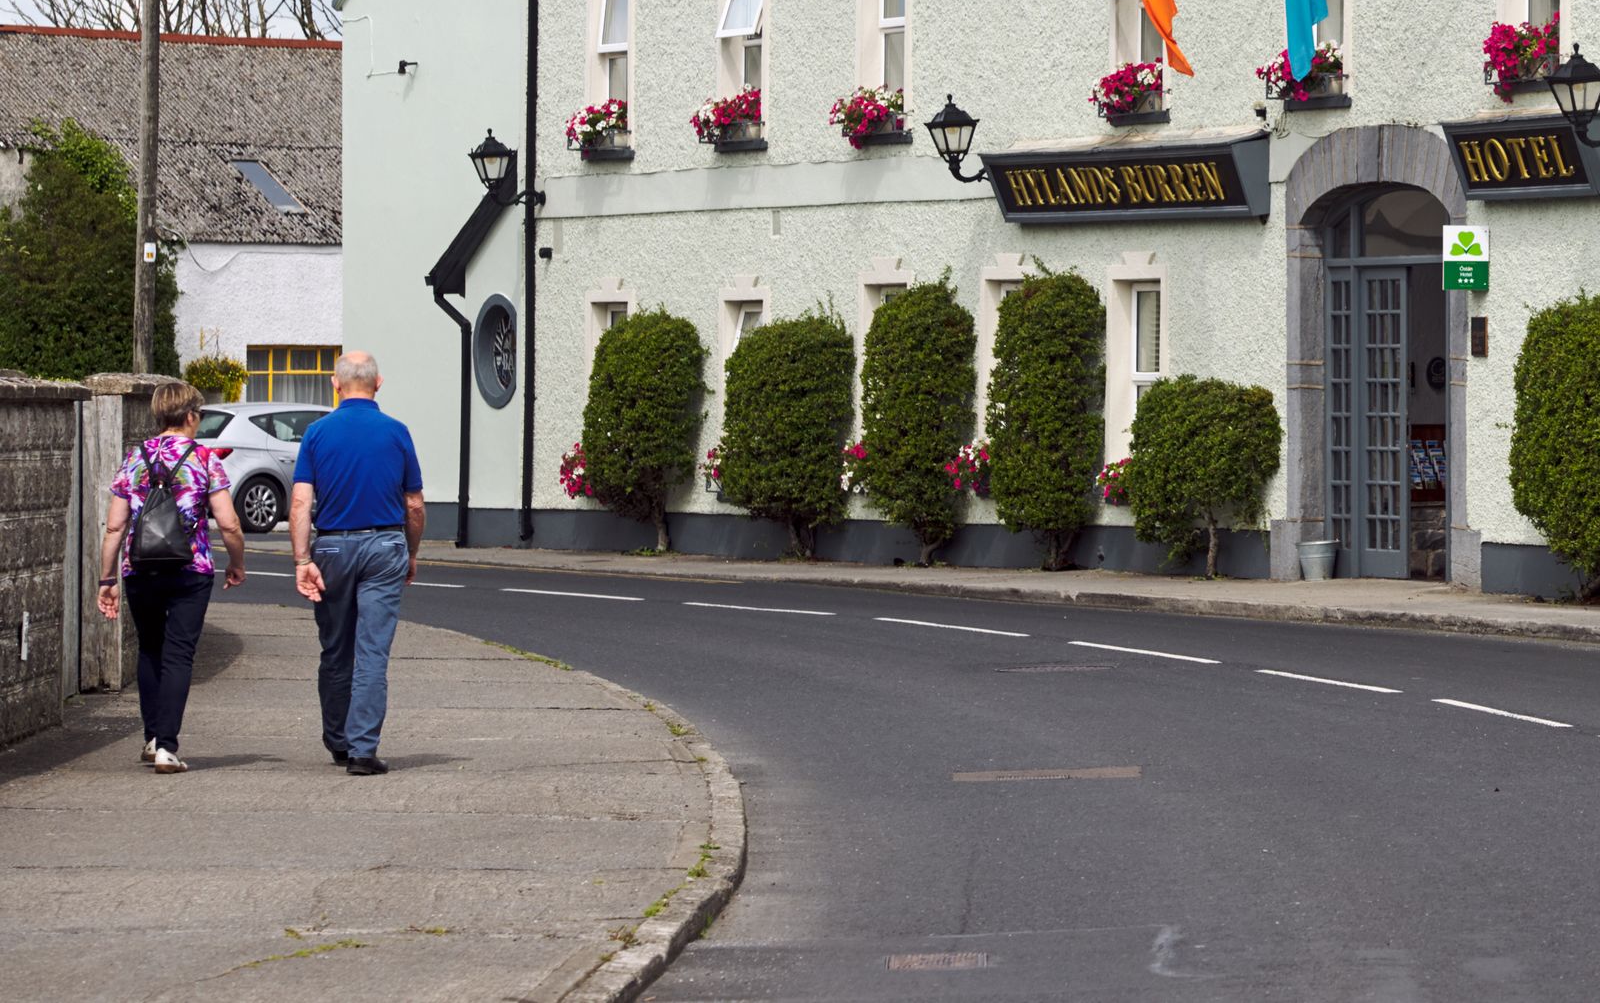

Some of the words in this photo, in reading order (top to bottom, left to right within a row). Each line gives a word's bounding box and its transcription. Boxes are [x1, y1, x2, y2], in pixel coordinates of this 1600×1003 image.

[1459, 135, 1574, 182] HOTEL
[1005, 166, 1120, 206] HYLANDS
[1120, 162, 1225, 204] BURREN
